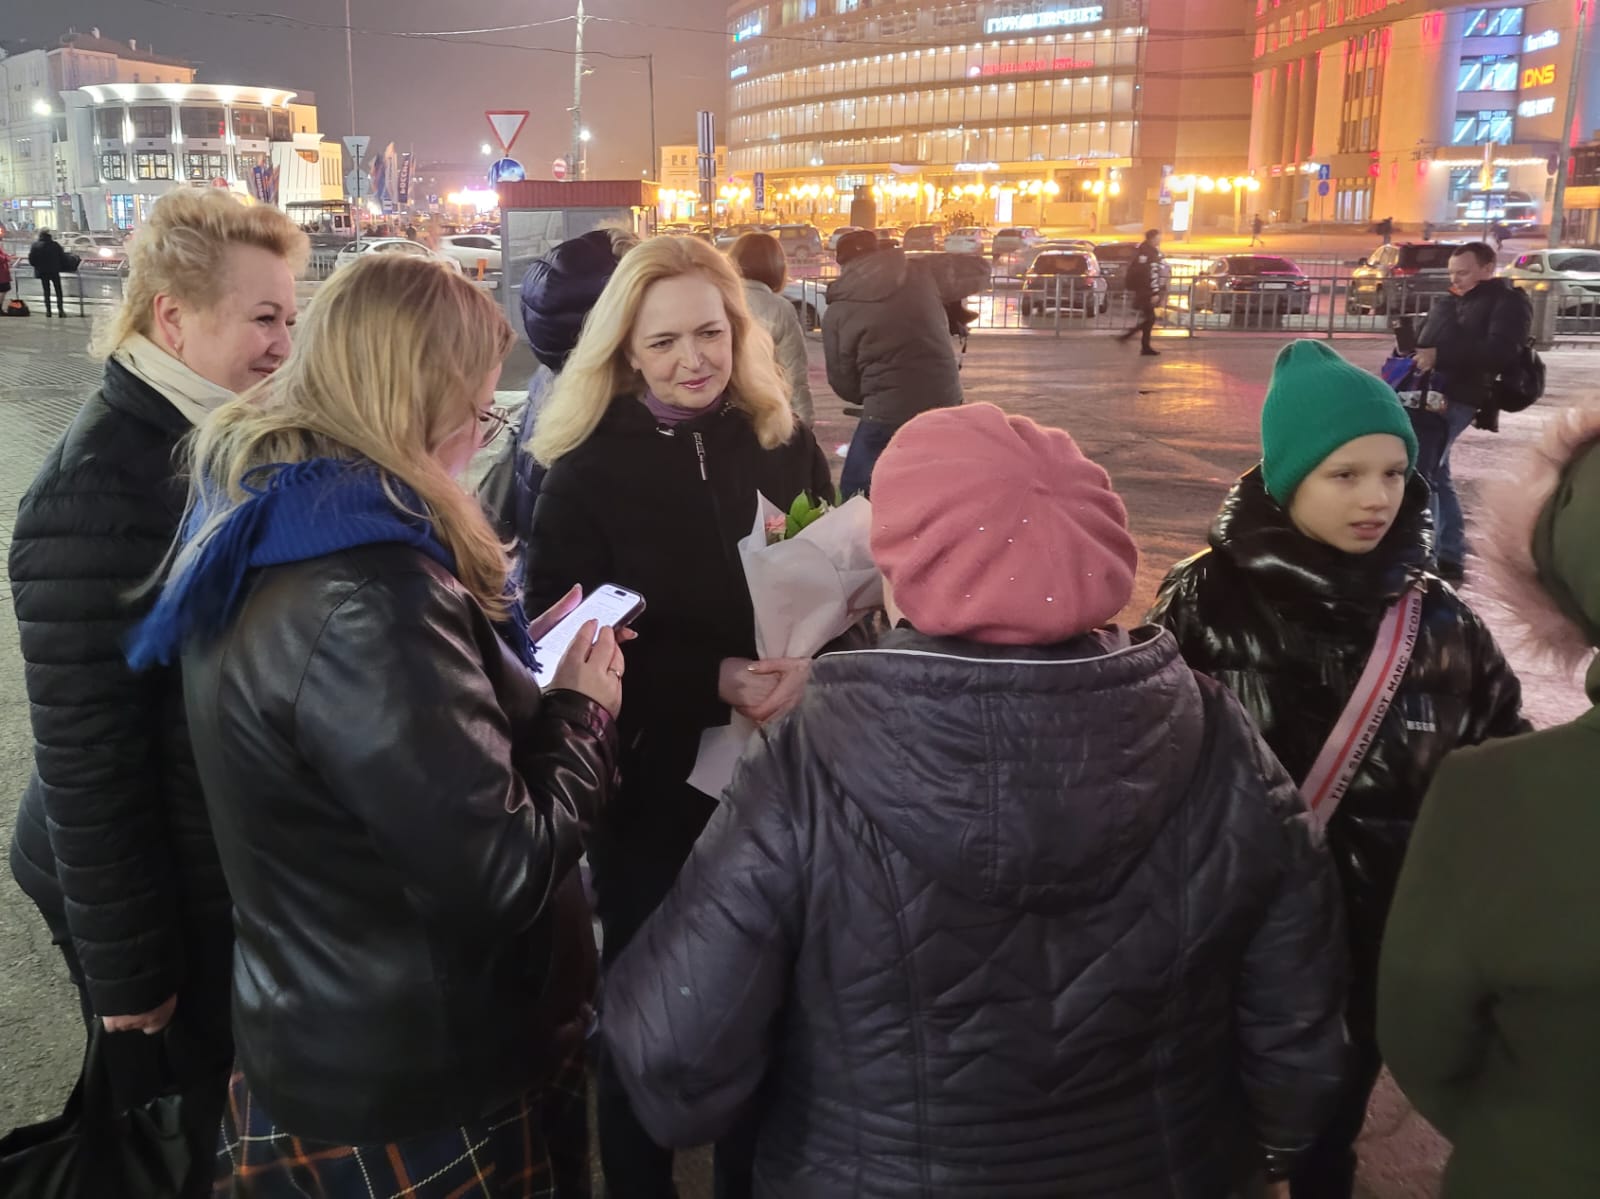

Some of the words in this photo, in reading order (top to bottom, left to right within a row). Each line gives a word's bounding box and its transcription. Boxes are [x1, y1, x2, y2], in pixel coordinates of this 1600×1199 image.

[1522, 64, 1555, 89] DNS
[1330, 774, 1350, 801] THE
[1349, 698, 1390, 769] SNAPSHOT
[1386, 656, 1408, 692] MARC
[1404, 598, 1421, 651] JACOBS
